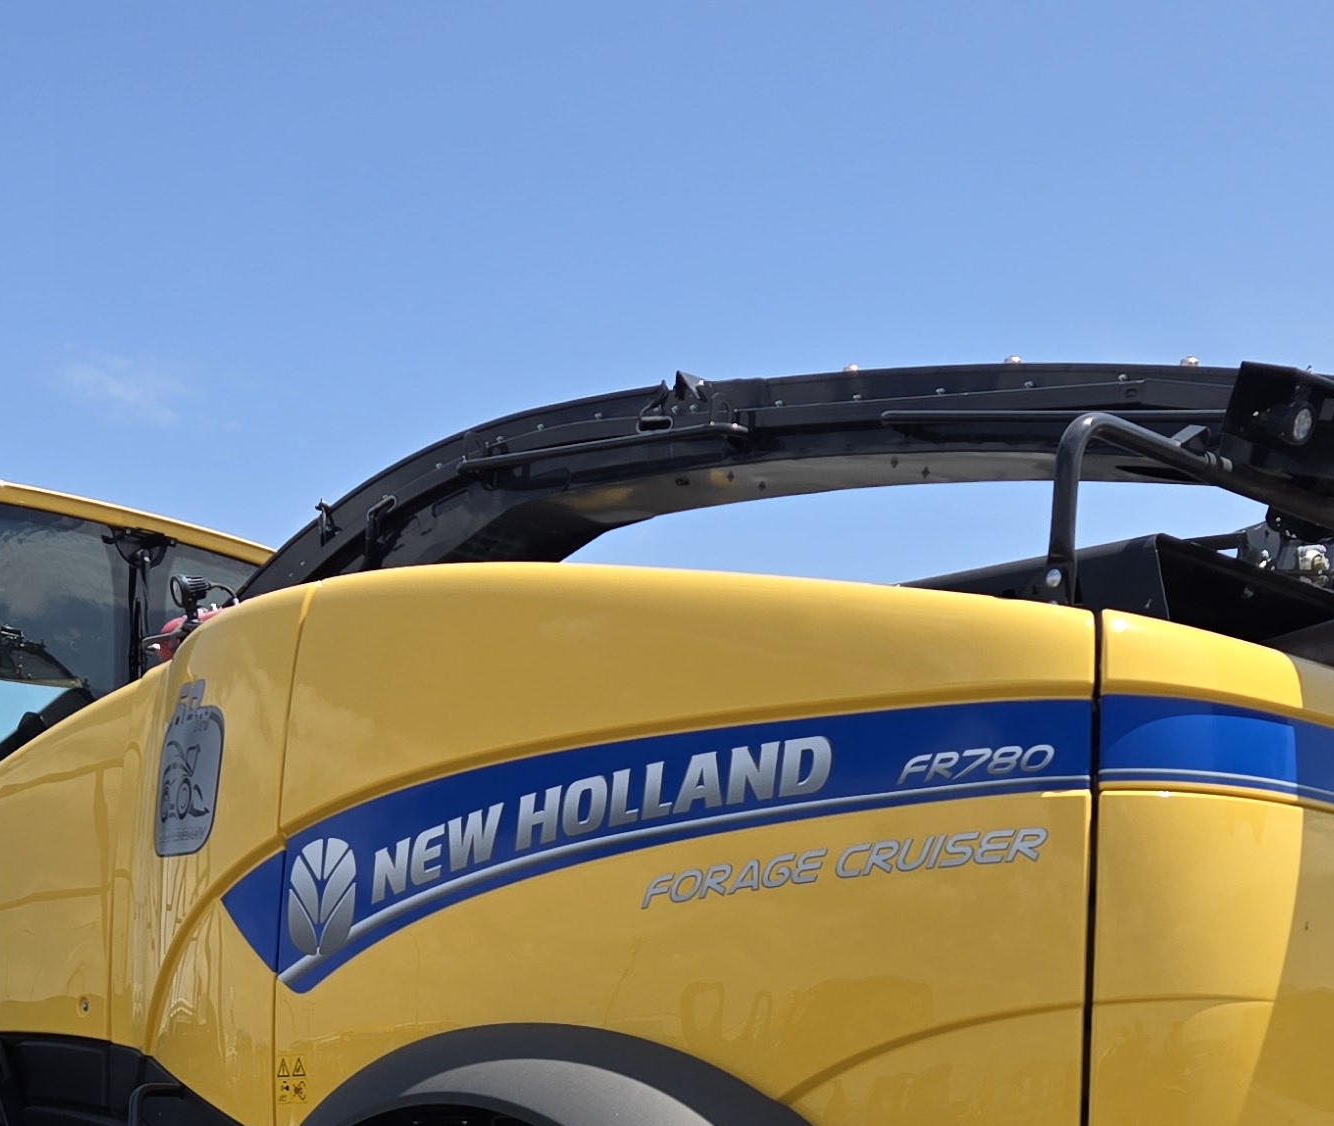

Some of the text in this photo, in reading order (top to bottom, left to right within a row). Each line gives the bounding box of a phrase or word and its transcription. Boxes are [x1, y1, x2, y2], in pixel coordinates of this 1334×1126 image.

[897, 743, 1055, 785] FR780
[371, 735, 834, 906] NEW HOLLAND
[640, 826, 1049, 911] FORAGE CRUISER
